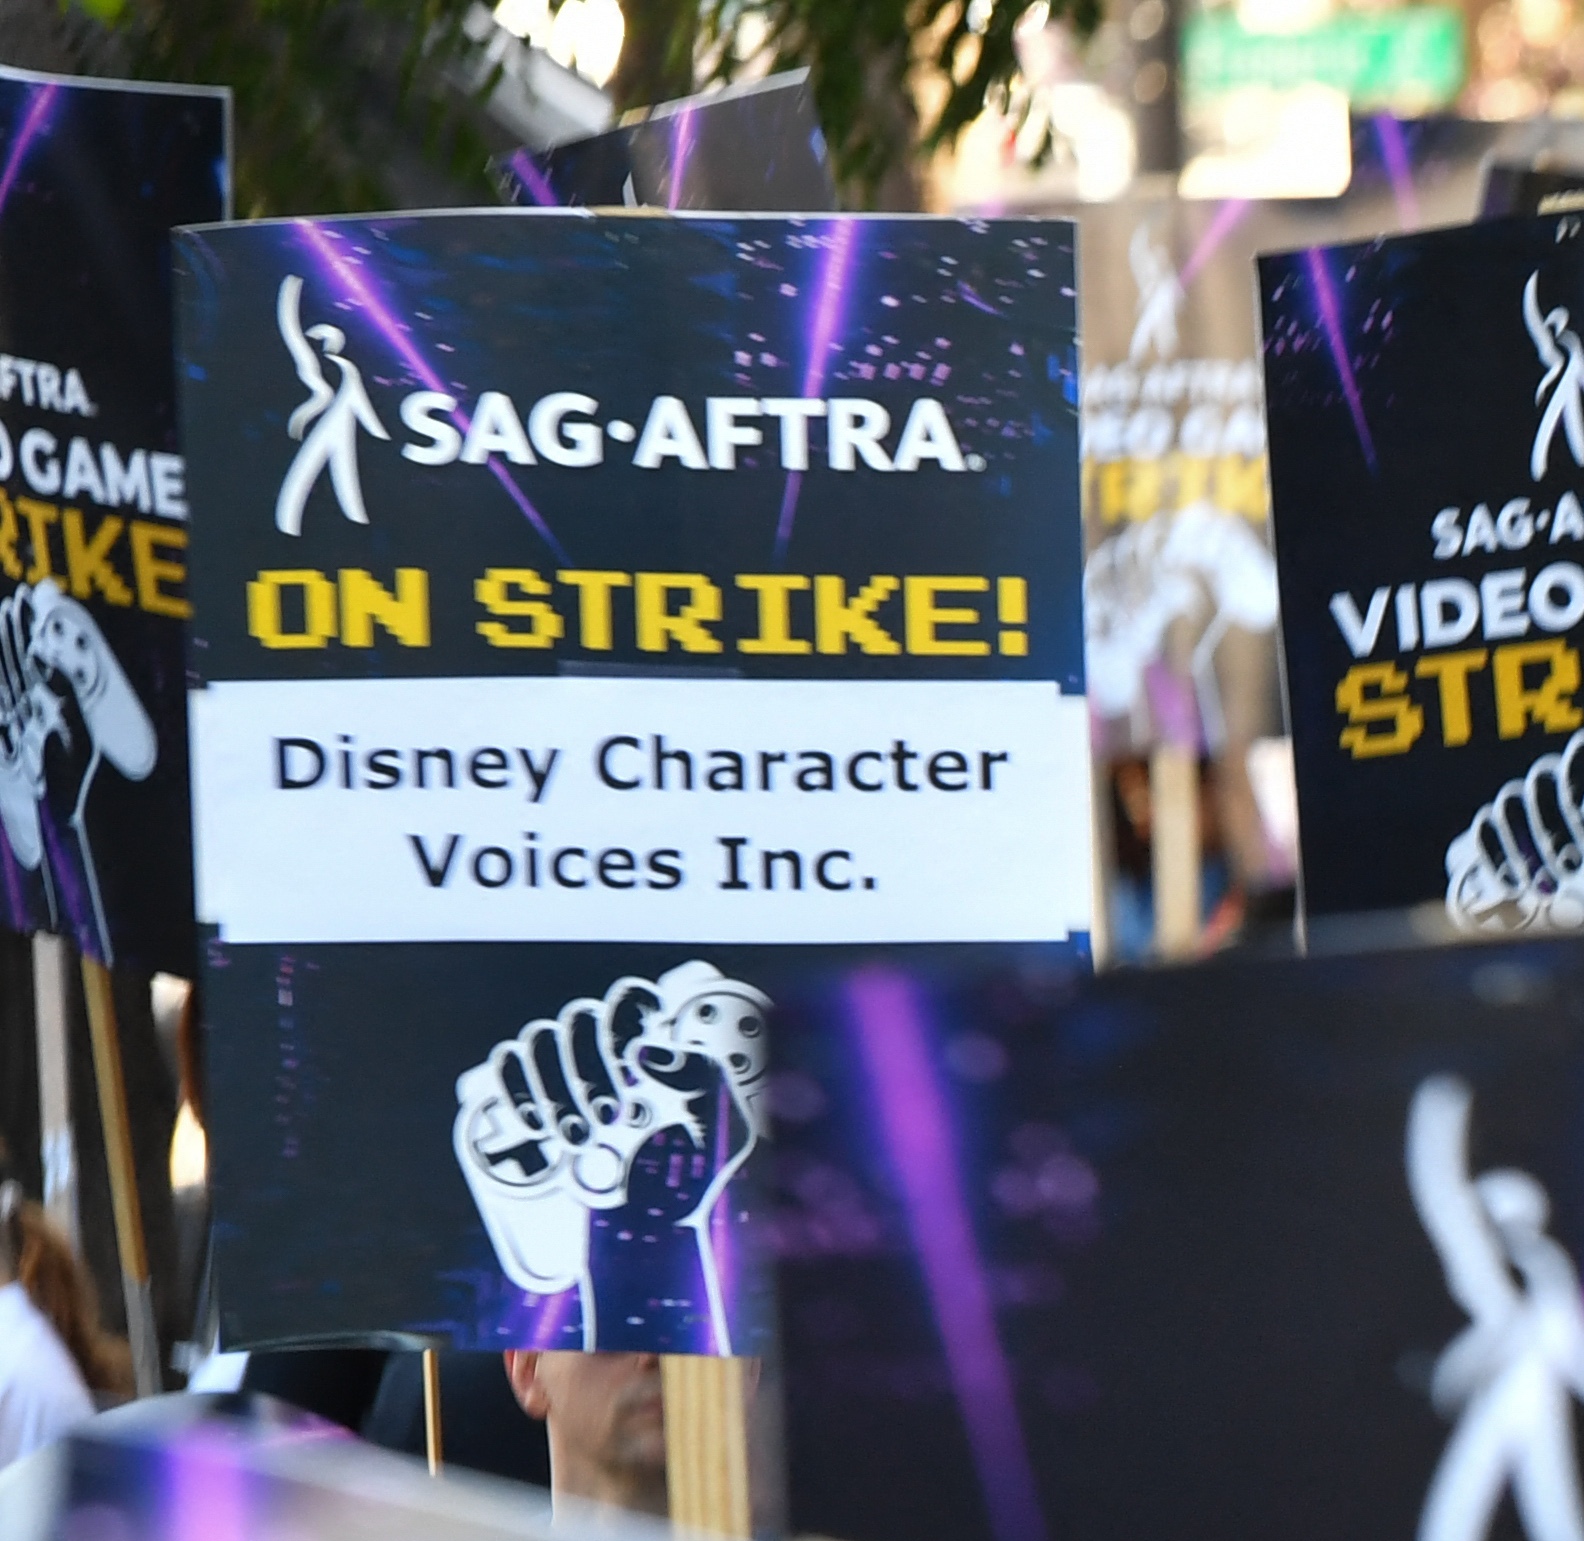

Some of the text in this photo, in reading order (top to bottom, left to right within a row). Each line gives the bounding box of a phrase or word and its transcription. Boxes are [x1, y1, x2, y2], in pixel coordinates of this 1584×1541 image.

[19, 427, 189, 522] GAME
[246, 567, 1030, 657] ON STRIKE!
[274, 734, 1010, 802] Disney Character
[407, 832, 880, 893] Voices Inc.
